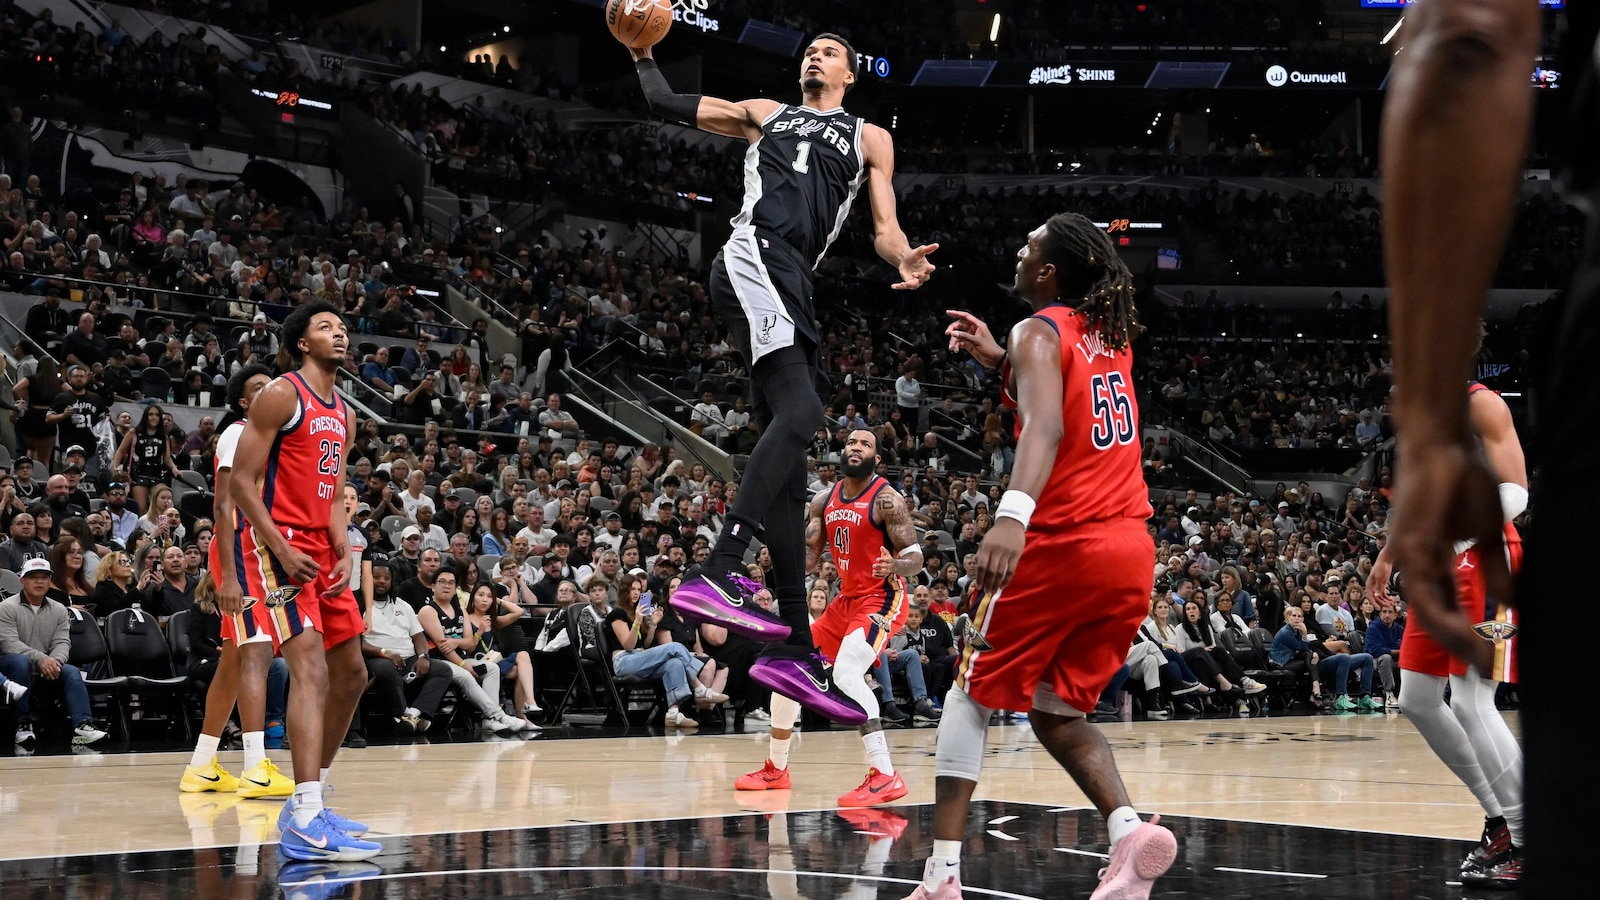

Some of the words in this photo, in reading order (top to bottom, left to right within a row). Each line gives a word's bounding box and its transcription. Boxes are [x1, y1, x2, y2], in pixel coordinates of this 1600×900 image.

[683, 10, 719, 32] Clips
[1028, 65, 1072, 84] Shiner
[1290, 71, 1346, 83] Ownwell
[791, 141, 812, 175] 1
[1090, 371, 1136, 450] 55
[310, 416, 347, 443] CRESCENT
[144, 446, 158, 457] 21
[318, 439, 342, 476] 25
[825, 509, 863, 526] CRESCENT
[834, 526, 850, 554] 41
